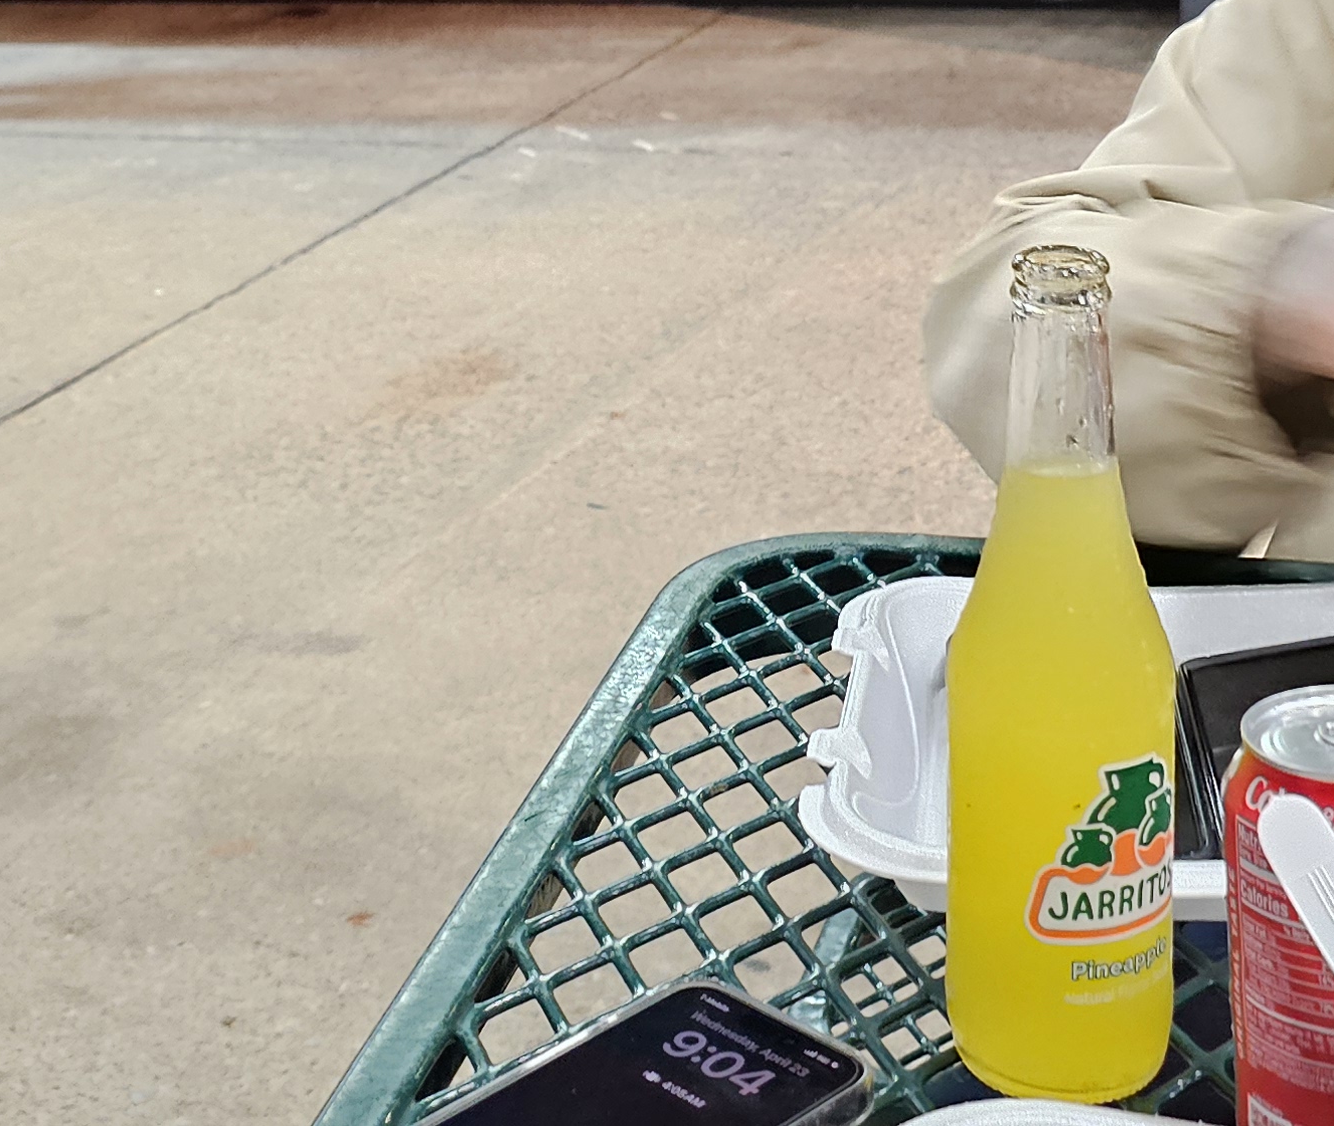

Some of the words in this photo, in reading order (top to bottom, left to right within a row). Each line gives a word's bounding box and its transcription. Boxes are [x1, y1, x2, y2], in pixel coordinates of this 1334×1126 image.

[1240, 876, 1290, 919] Calories
[1072, 936, 1166, 981] Pineapple
[663, 1030, 776, 1096] 9:04
